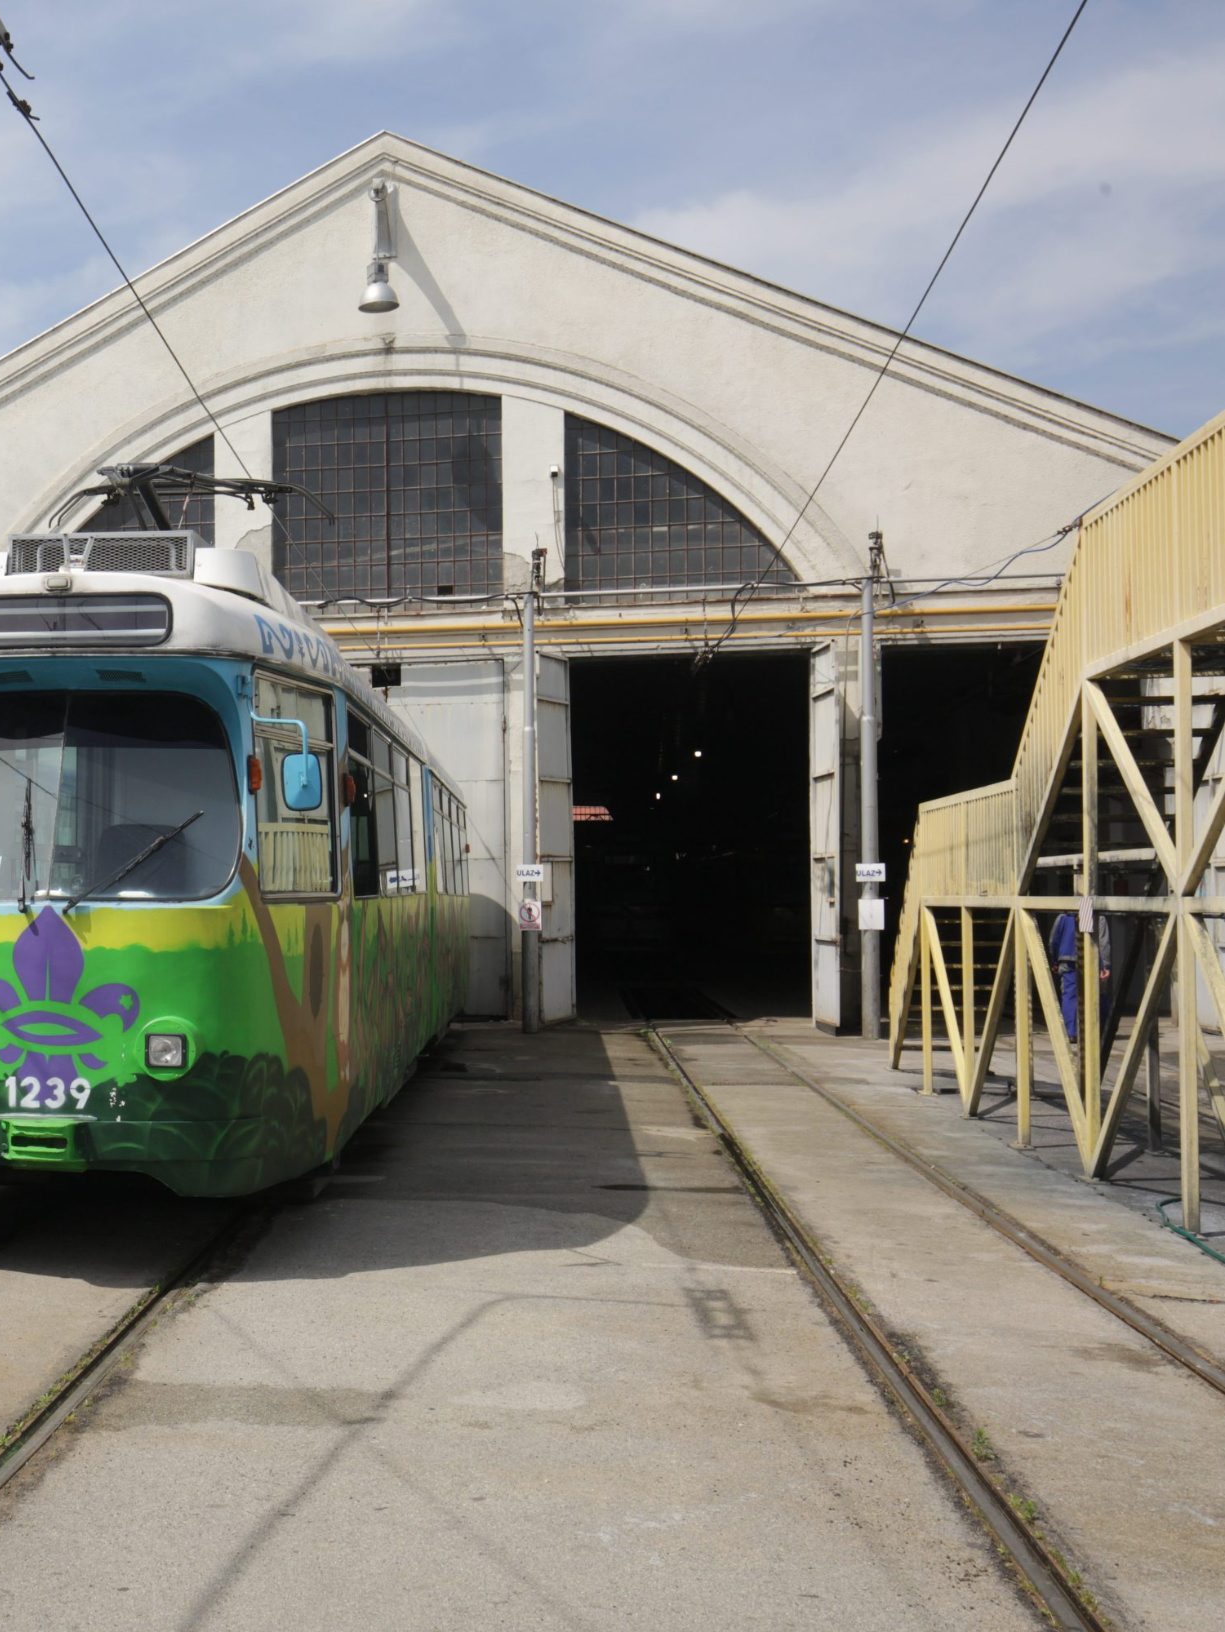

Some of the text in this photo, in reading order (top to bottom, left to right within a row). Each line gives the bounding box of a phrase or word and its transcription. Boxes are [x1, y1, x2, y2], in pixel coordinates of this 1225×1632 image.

[516, 869, 535, 877] ULAZ
[856, 869, 875, 877] ULAZ
[5, 1076, 91, 1109] 1239
